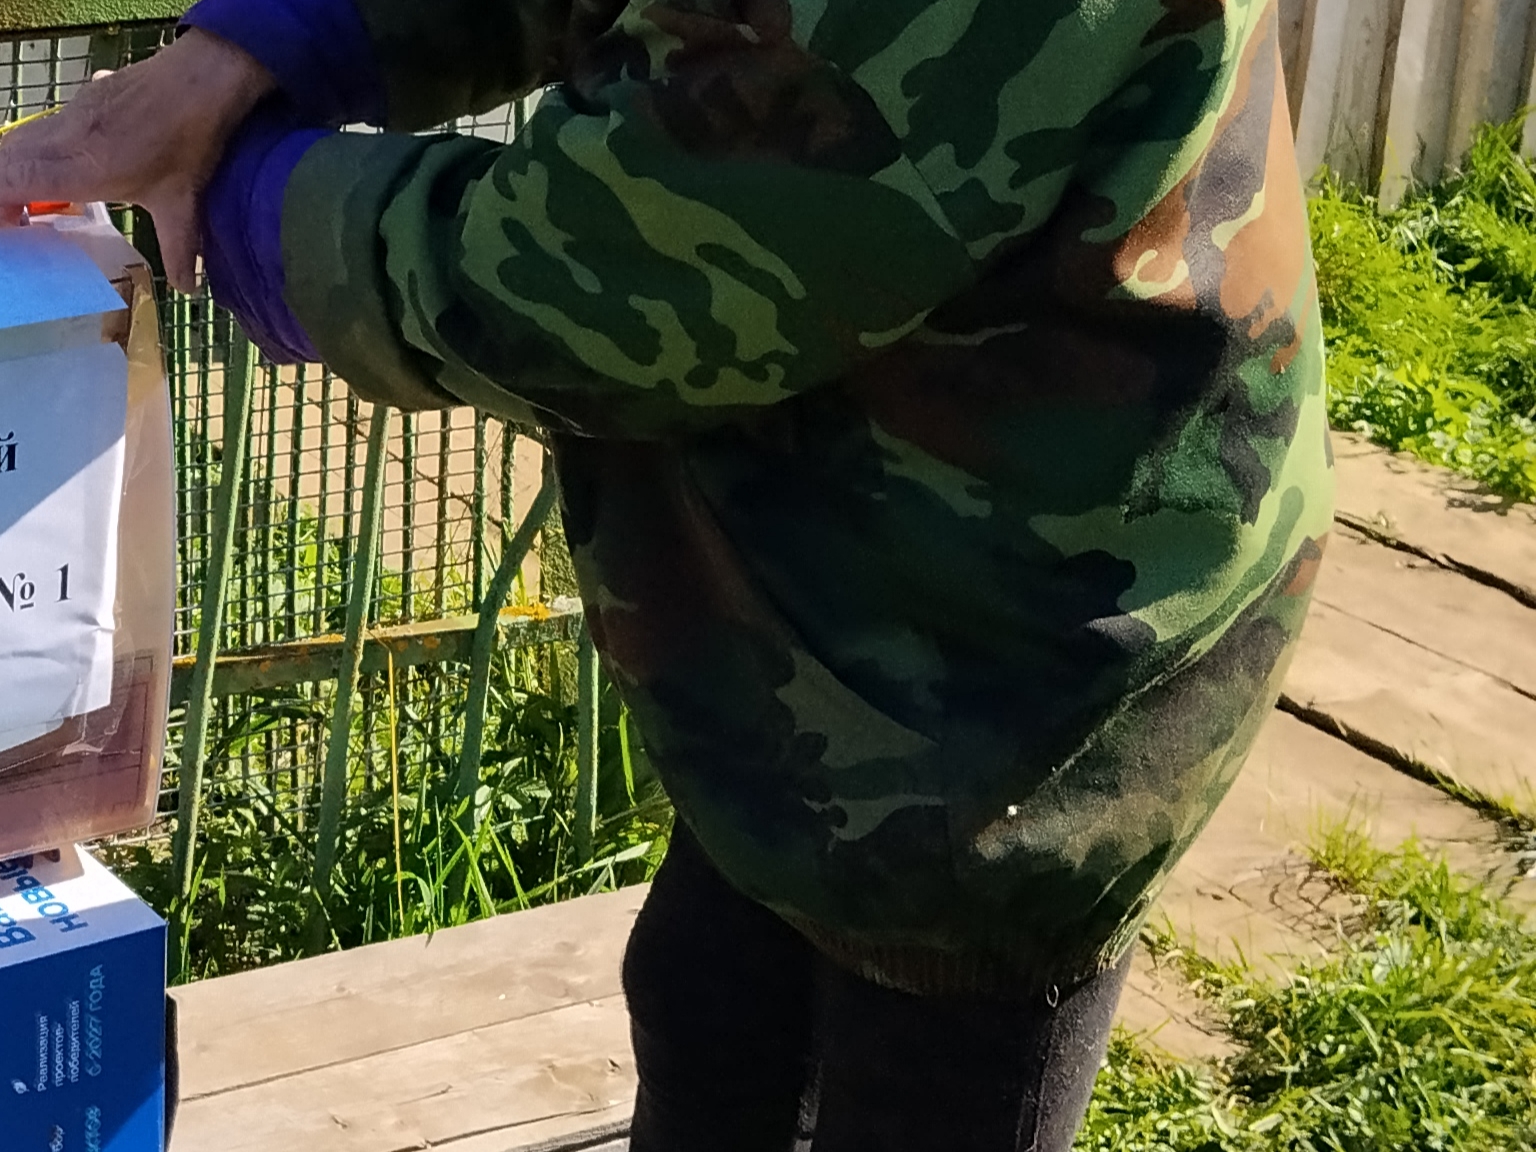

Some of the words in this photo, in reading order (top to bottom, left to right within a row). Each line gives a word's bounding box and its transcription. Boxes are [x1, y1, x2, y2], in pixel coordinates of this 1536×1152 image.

[55, 562, 73, 602] 1
[88, 964, 106, 1012] ГОДА
[37, 1014, 50, 1092] Реализация
[68, 1000, 81, 1083] победителей
